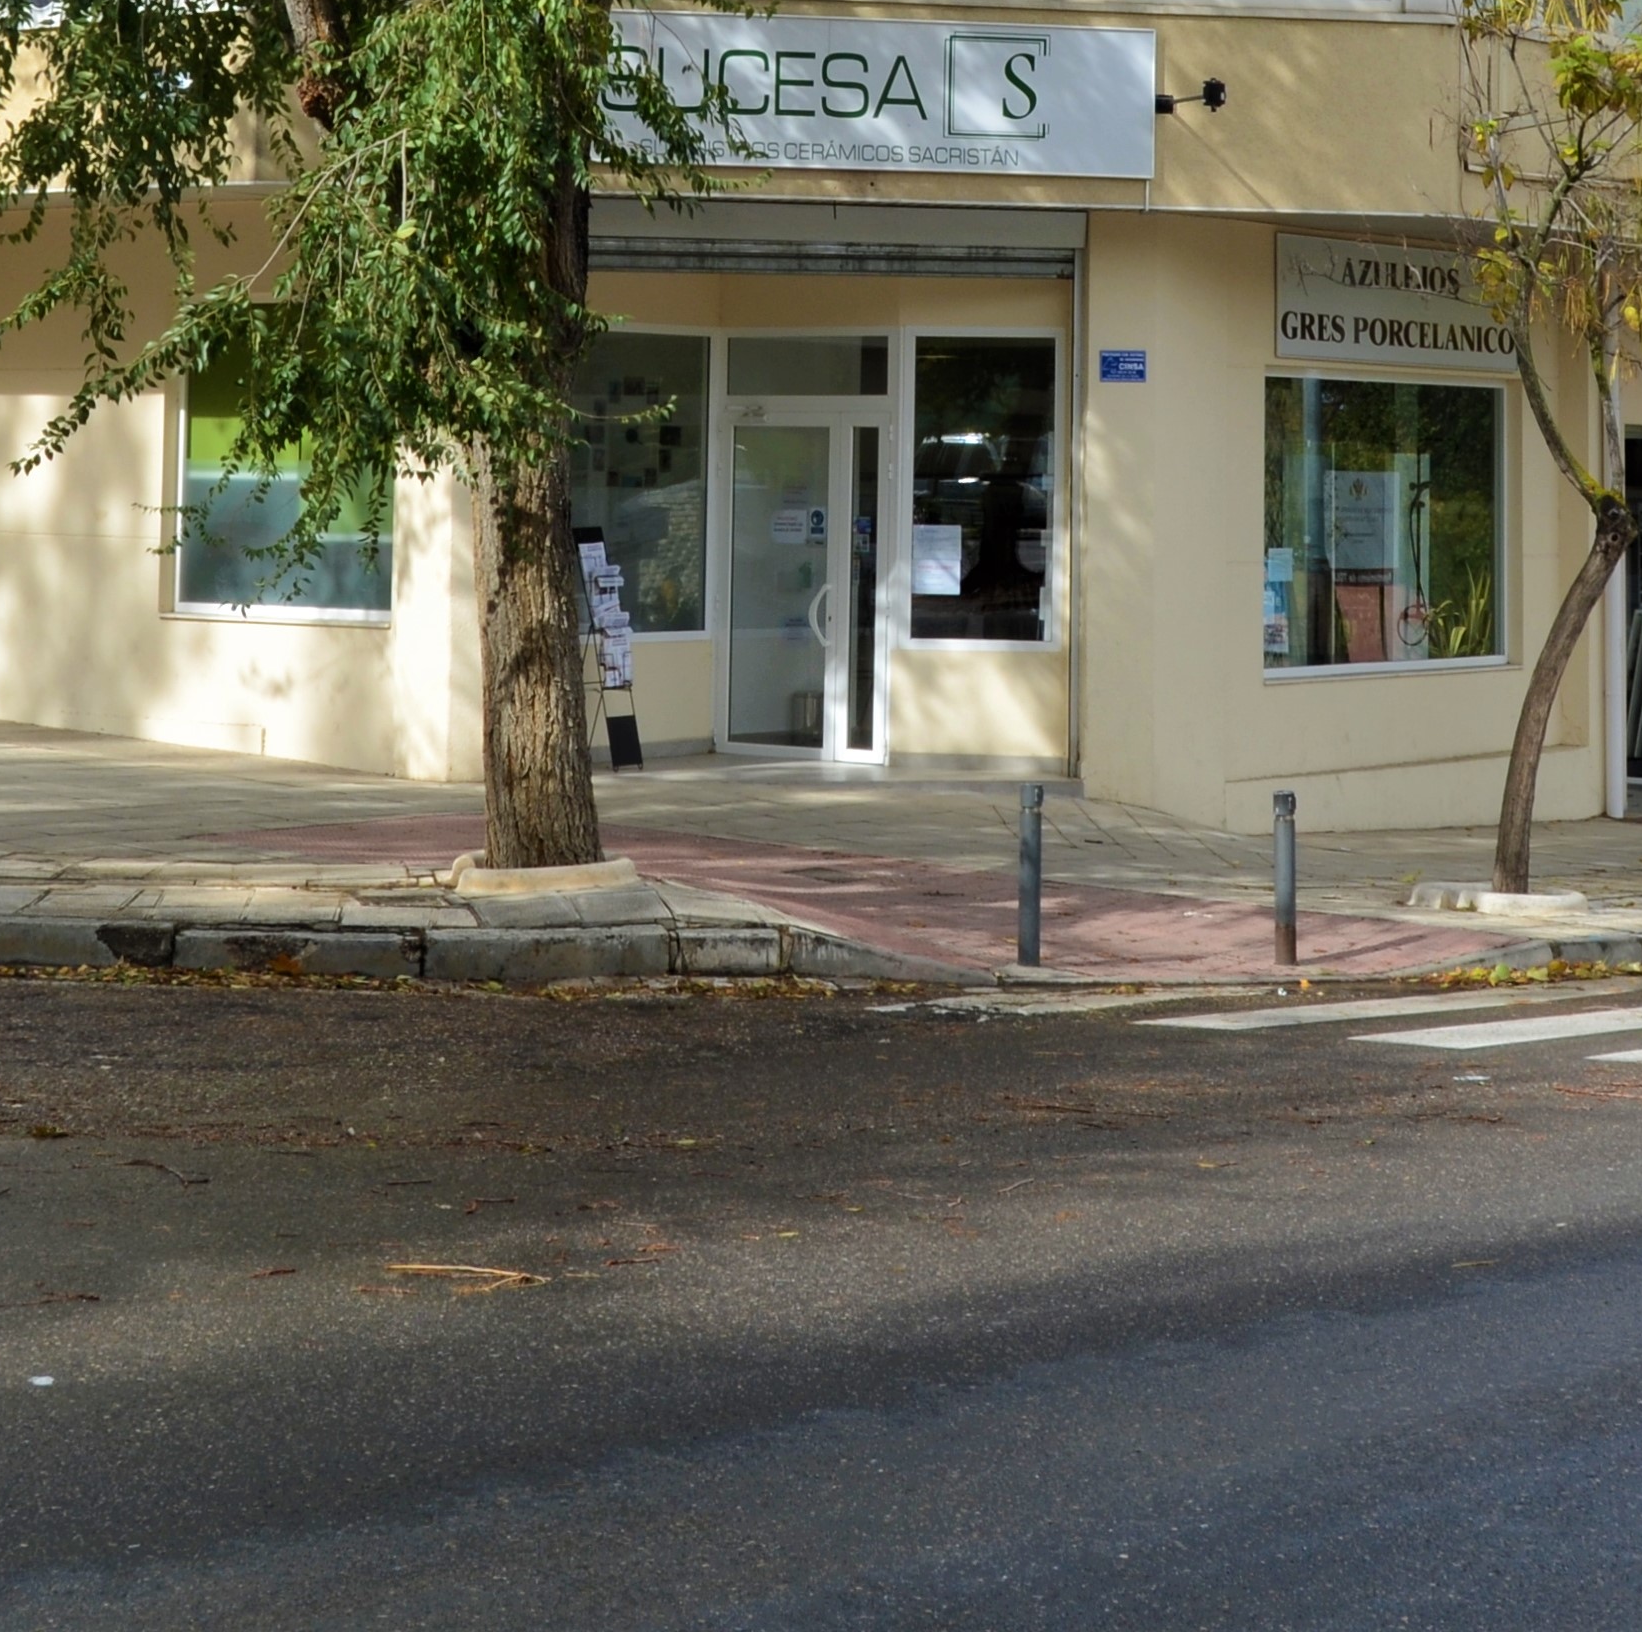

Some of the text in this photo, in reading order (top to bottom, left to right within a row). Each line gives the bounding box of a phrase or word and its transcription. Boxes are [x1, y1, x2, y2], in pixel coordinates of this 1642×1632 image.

[601, 45, 928, 121] SUCESA
[784, 140, 904, 163] CERÁMICOS
[909, 144, 1019, 166] SACRISTÁN
[1342, 258, 1460, 295] AZULEJOS
[1281, 311, 1515, 355] GRES PORCELANICO
